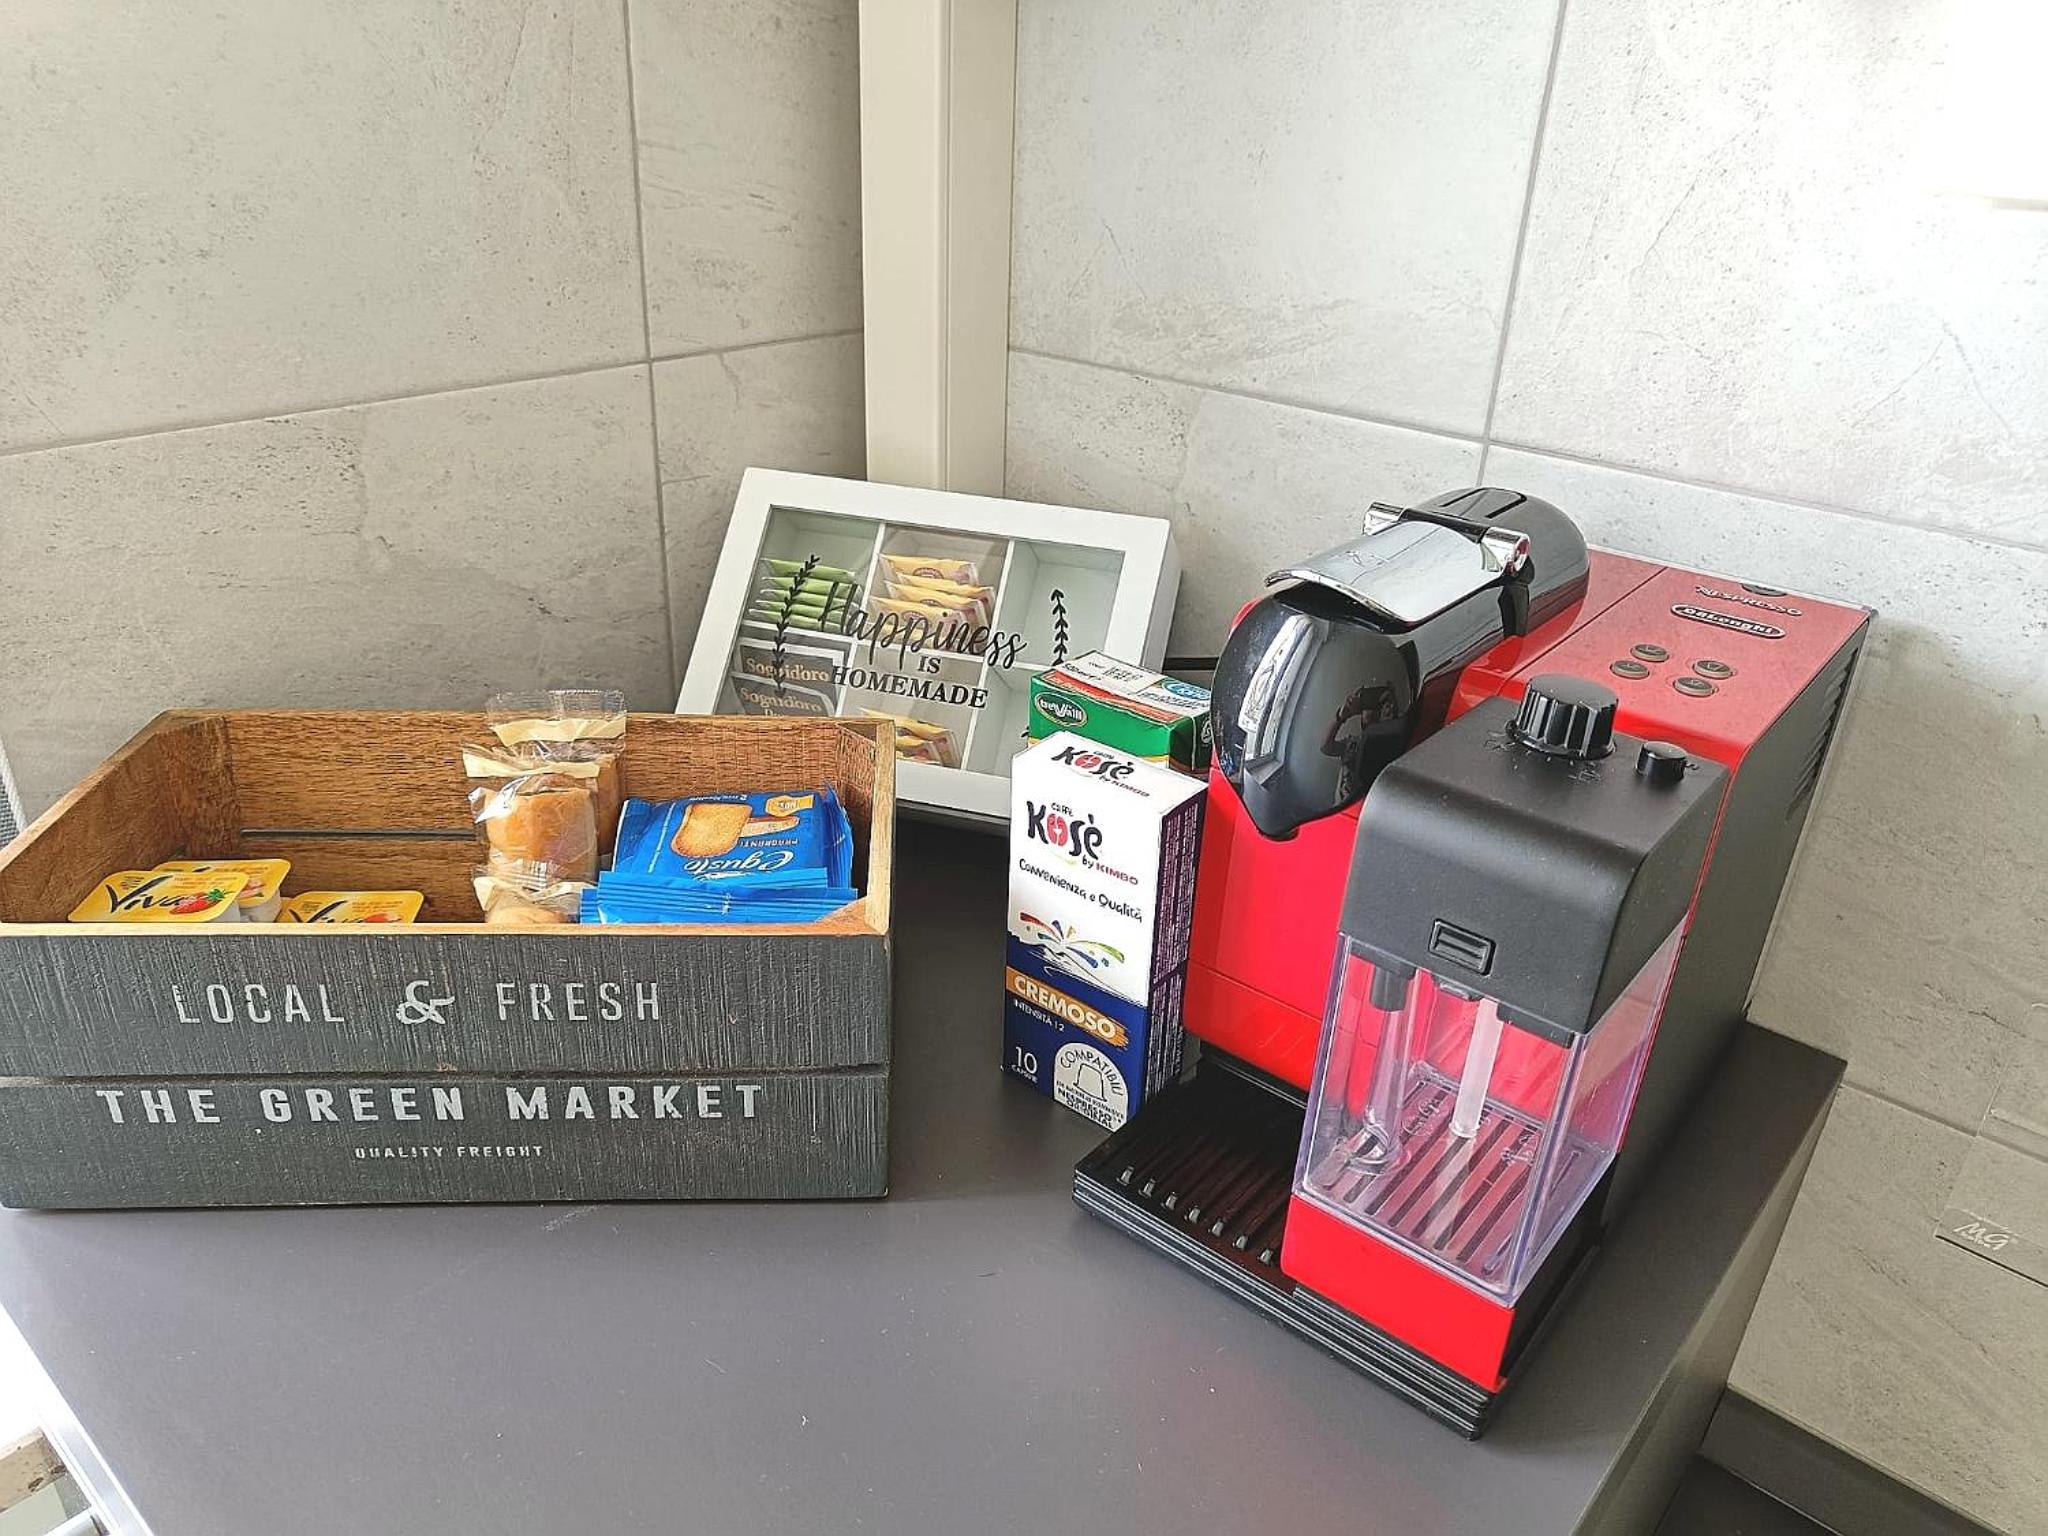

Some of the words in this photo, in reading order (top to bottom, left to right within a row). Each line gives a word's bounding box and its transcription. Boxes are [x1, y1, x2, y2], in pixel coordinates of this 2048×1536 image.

[818, 582, 1028, 671] Happiness
[918, 656, 942, 674] IS
[832, 665, 989, 709] HOMEMADE
[1019, 858, 1088, 901] Convenienza
[1082, 855, 1095, 869] by
[1095, 864, 1139, 886] KIMBO
[171, 983, 345, 1024] LOCAL
[395, 980, 456, 1025] &
[495, 982, 660, 1021] FRESH
[1014, 975, 1116, 1039] CREMOSO
[1015, 1046, 1038, 1075] 10
[96, 1089, 221, 1124] THE
[259, 1087, 465, 1123] GREEN
[506, 1084, 762, 1120] MARKET
[355, 1146, 443, 1159] QUALITY
[457, 1145, 543, 1158] FREIGHT
